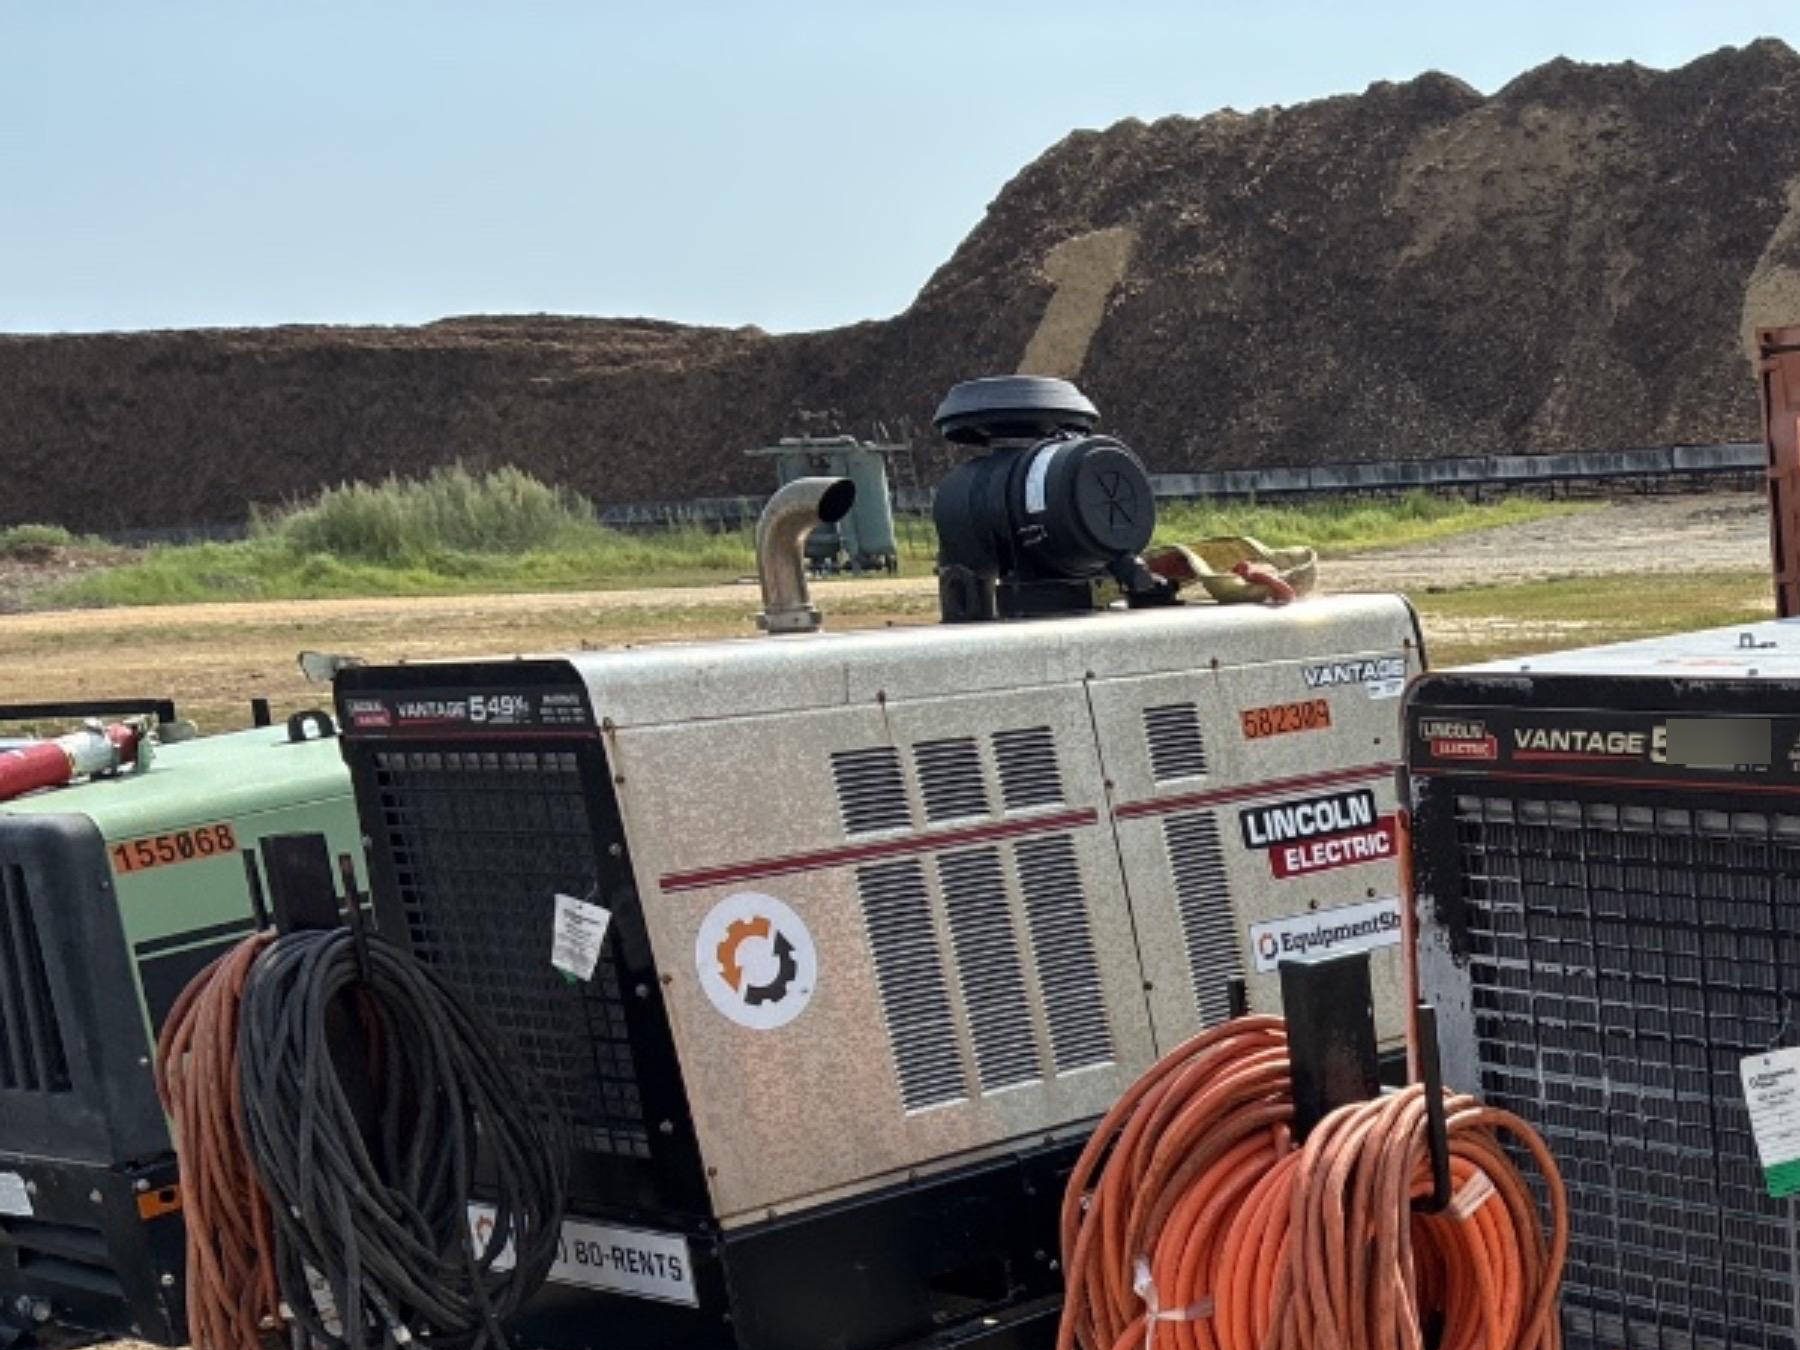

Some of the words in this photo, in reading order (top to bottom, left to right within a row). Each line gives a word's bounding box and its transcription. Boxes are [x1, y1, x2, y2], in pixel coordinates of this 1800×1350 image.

[1303, 658, 1406, 687] VANTAGE
[1513, 727, 1646, 754] VANTAGE
[1247, 795, 1372, 845] LINCOLN
[114, 824, 236, 871] 155068
[1283, 830, 1391, 873] ELECTRIC
[1281, 910, 1401, 954] EquipmentSh
[574, 1238, 684, 1282] 80-RENTS
